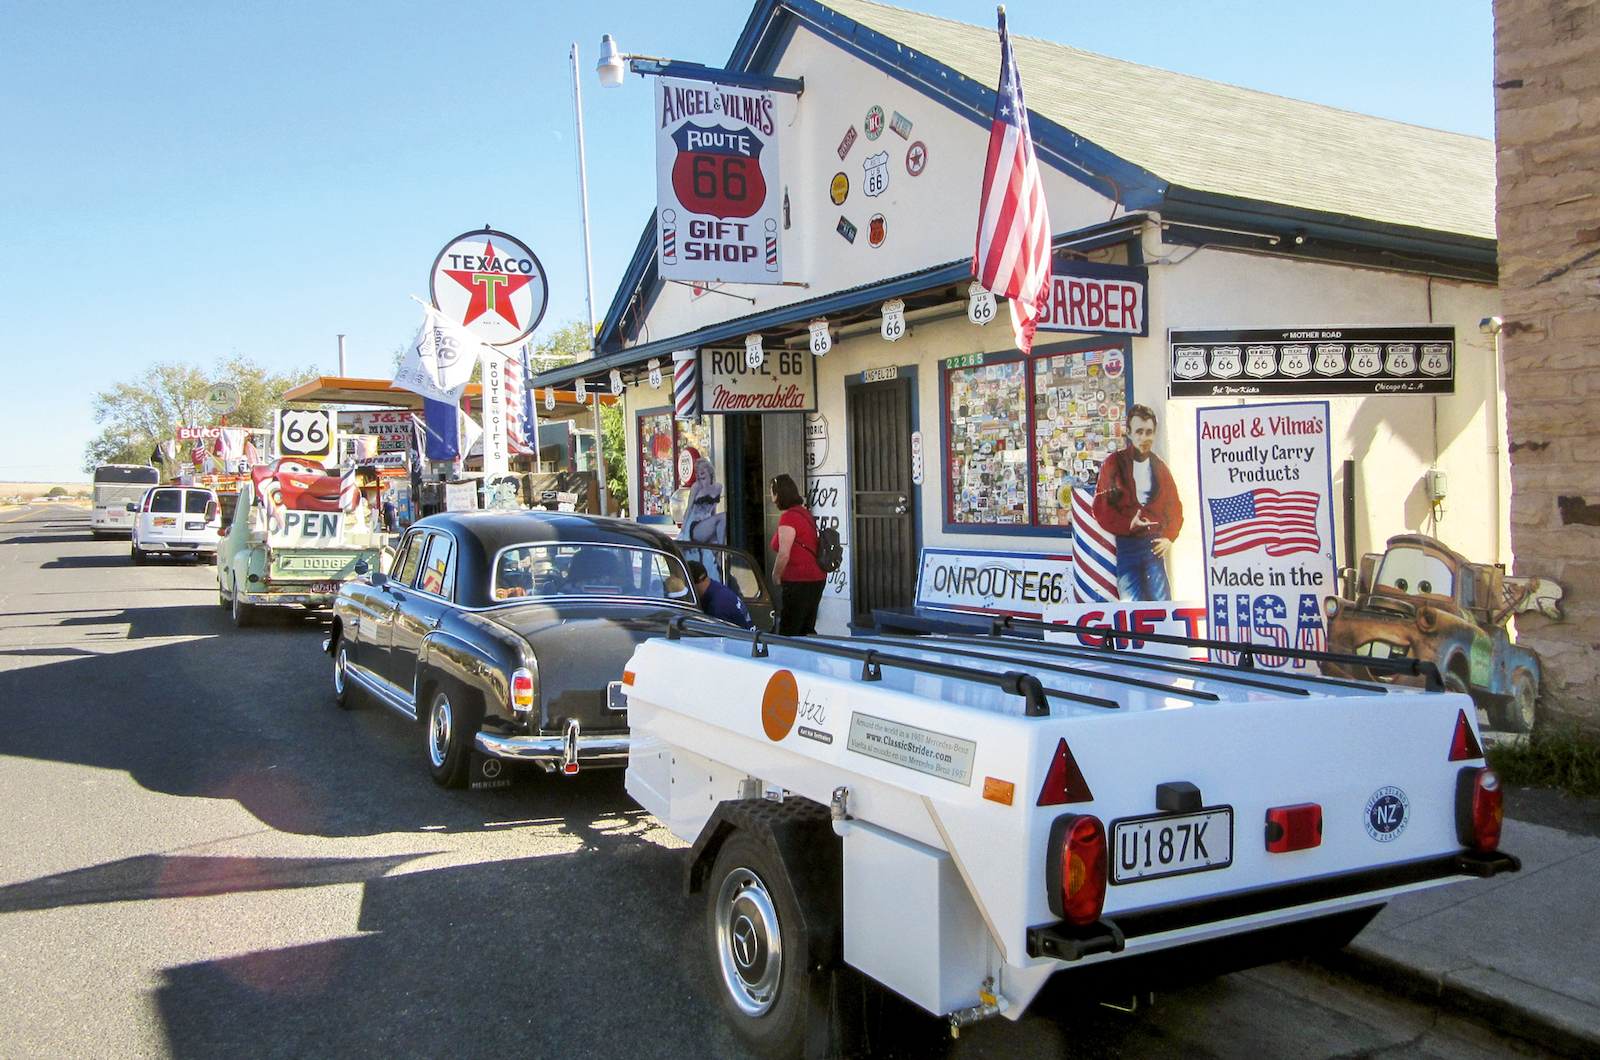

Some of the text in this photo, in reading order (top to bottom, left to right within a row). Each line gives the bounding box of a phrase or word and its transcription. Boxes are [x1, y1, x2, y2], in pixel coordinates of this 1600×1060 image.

[661, 85, 775, 137] ANGEL & VILMA'S
[687, 130, 750, 156] ROUTE
[692, 155, 748, 201] 66
[870, 174, 882, 192] 66
[689, 220, 749, 242] GIFT
[684, 242, 758, 263] SHOP
[448, 254, 533, 274] TEXACO
[474, 274, 508, 311] T
[974, 302, 990, 320] 66
[886, 320, 901, 336] 66
[814, 337, 827, 352] 66
[712, 351, 803, 376] ROUE 66
[749, 352, 760, 365] 66
[946, 353, 984, 369] 22265
[1184, 361, 1198, 370] 66
[1218, 360, 1233, 370] 66
[1254, 360, 1268, 370] 66
[1288, 360, 1302, 369] 66
[1324, 359, 1338, 368] 66
[1358, 359, 1373, 368] 66
[1394, 358, 1408, 368] 66
[1428, 358, 1442, 368] 66
[490, 362, 499, 404] ROUTE
[612, 383, 621, 392] 66
[651, 376, 660, 385] 66
[1224, 386, 1240, 394] Your
[1240, 386, 1260, 394] Kicks
[1374, 383, 1401, 392] Chicago
[546, 398, 554, 407] 66
[577, 392, 584, 401] 66
[712, 384, 805, 411] Memorabilia
[287, 419, 324, 443] 66
[492, 417, 501, 460] GIFTS
[1202, 415, 1324, 445] Angel & Vilma's
[360, 456, 402, 466] spresso
[1210, 444, 1315, 466] Proudly Carry
[1228, 464, 1300, 484] Products
[304, 558, 348, 568] DODGE
[934, 565, 1064, 604] ONROUTE66
[1210, 566, 1324, 587] Made in the
[1213, 594, 1328, 668] USA
[856, 718, 874, 730] Around
[874, 722, 883, 732] the
[884, 726, 898, 737] world
[899, 729, 905, 737] in
[910, 732, 924, 742] 1957
[925, 736, 969, 754] Mercedes-Benz
[866, 732, 952, 763] www.ClassicStrider.com
[851, 739, 967, 779] Vuelta al mundo en un Mercedes-Benz 1957
[472, 780, 511, 788] MERCEDES
[1366, 788, 1409, 814] NUEVA ZELANDA
[1377, 804, 1397, 824] NZ
[1366, 816, 1408, 841] NEW ZEALAND
[1122, 821, 1209, 870] U187K
